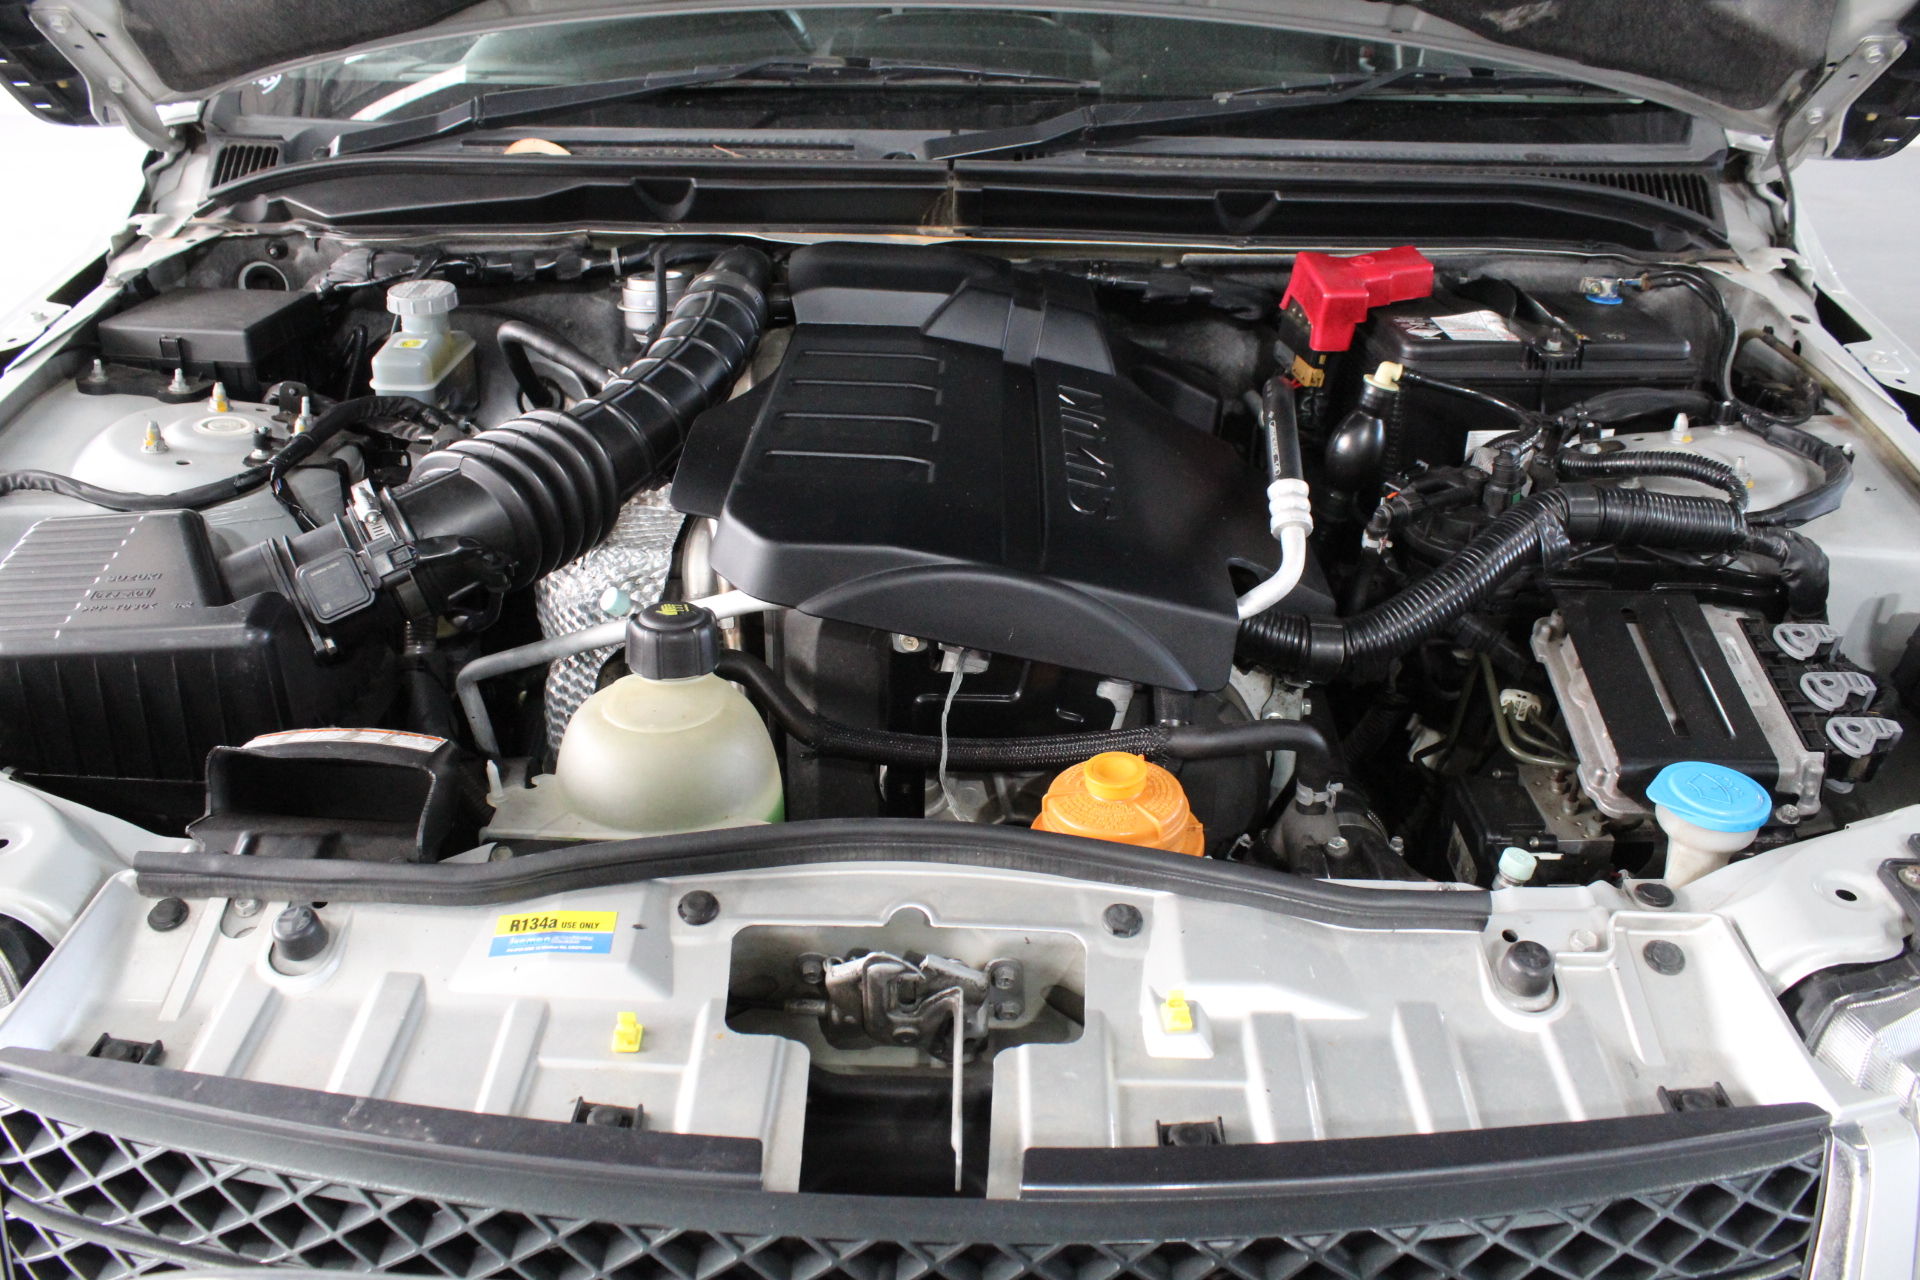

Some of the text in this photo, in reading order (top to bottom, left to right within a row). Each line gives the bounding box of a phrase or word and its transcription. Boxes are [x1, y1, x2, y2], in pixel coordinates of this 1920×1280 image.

[105, 573, 163, 582] SUZUKI
[509, 916, 558, 932] R134a
[561, 921, 578, 929] USE
